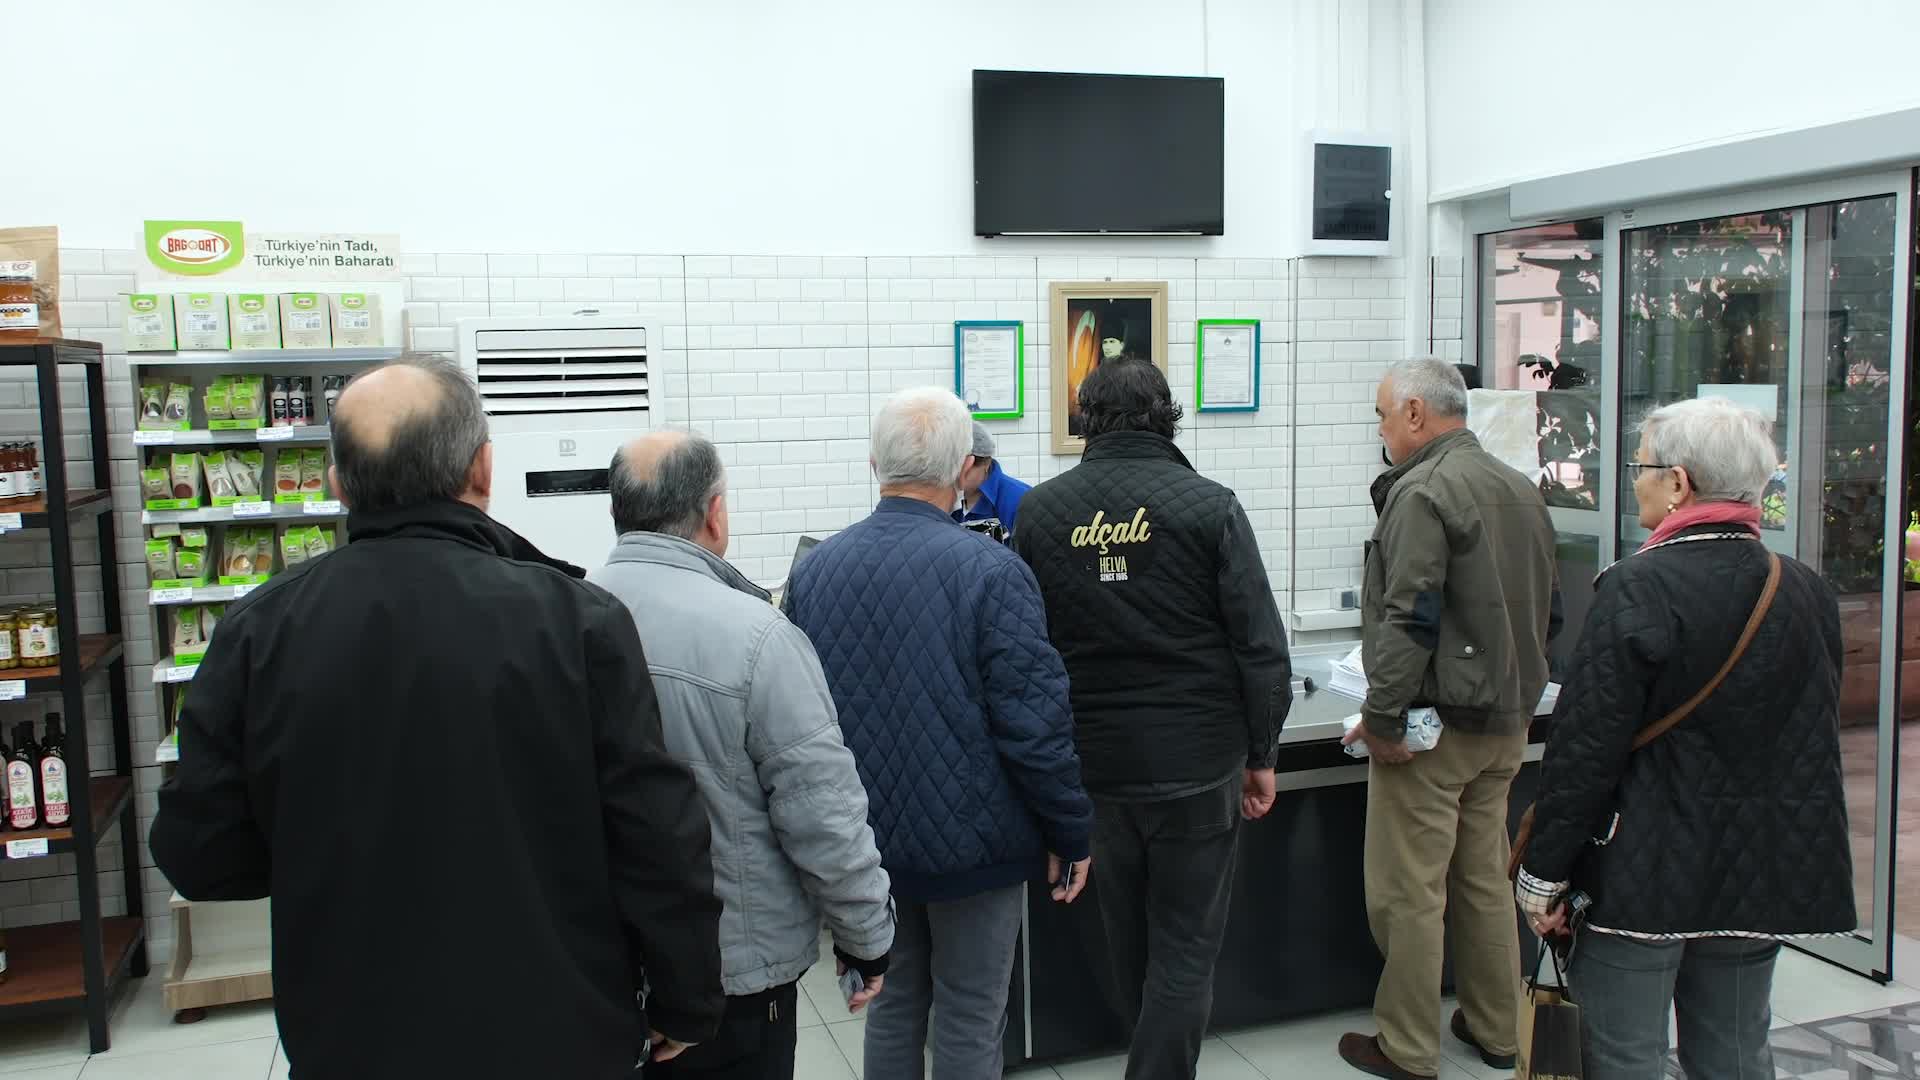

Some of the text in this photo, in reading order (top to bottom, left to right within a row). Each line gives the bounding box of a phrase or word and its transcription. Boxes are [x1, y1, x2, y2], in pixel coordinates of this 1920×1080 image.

[265, 239, 378, 254] Türkiye'nin Tadı,
[254, 254, 394, 269] Türkiye'nin Baharatı
[1099, 556, 1127, 573] HELVA
[1100, 573, 1115, 581] SINCE
